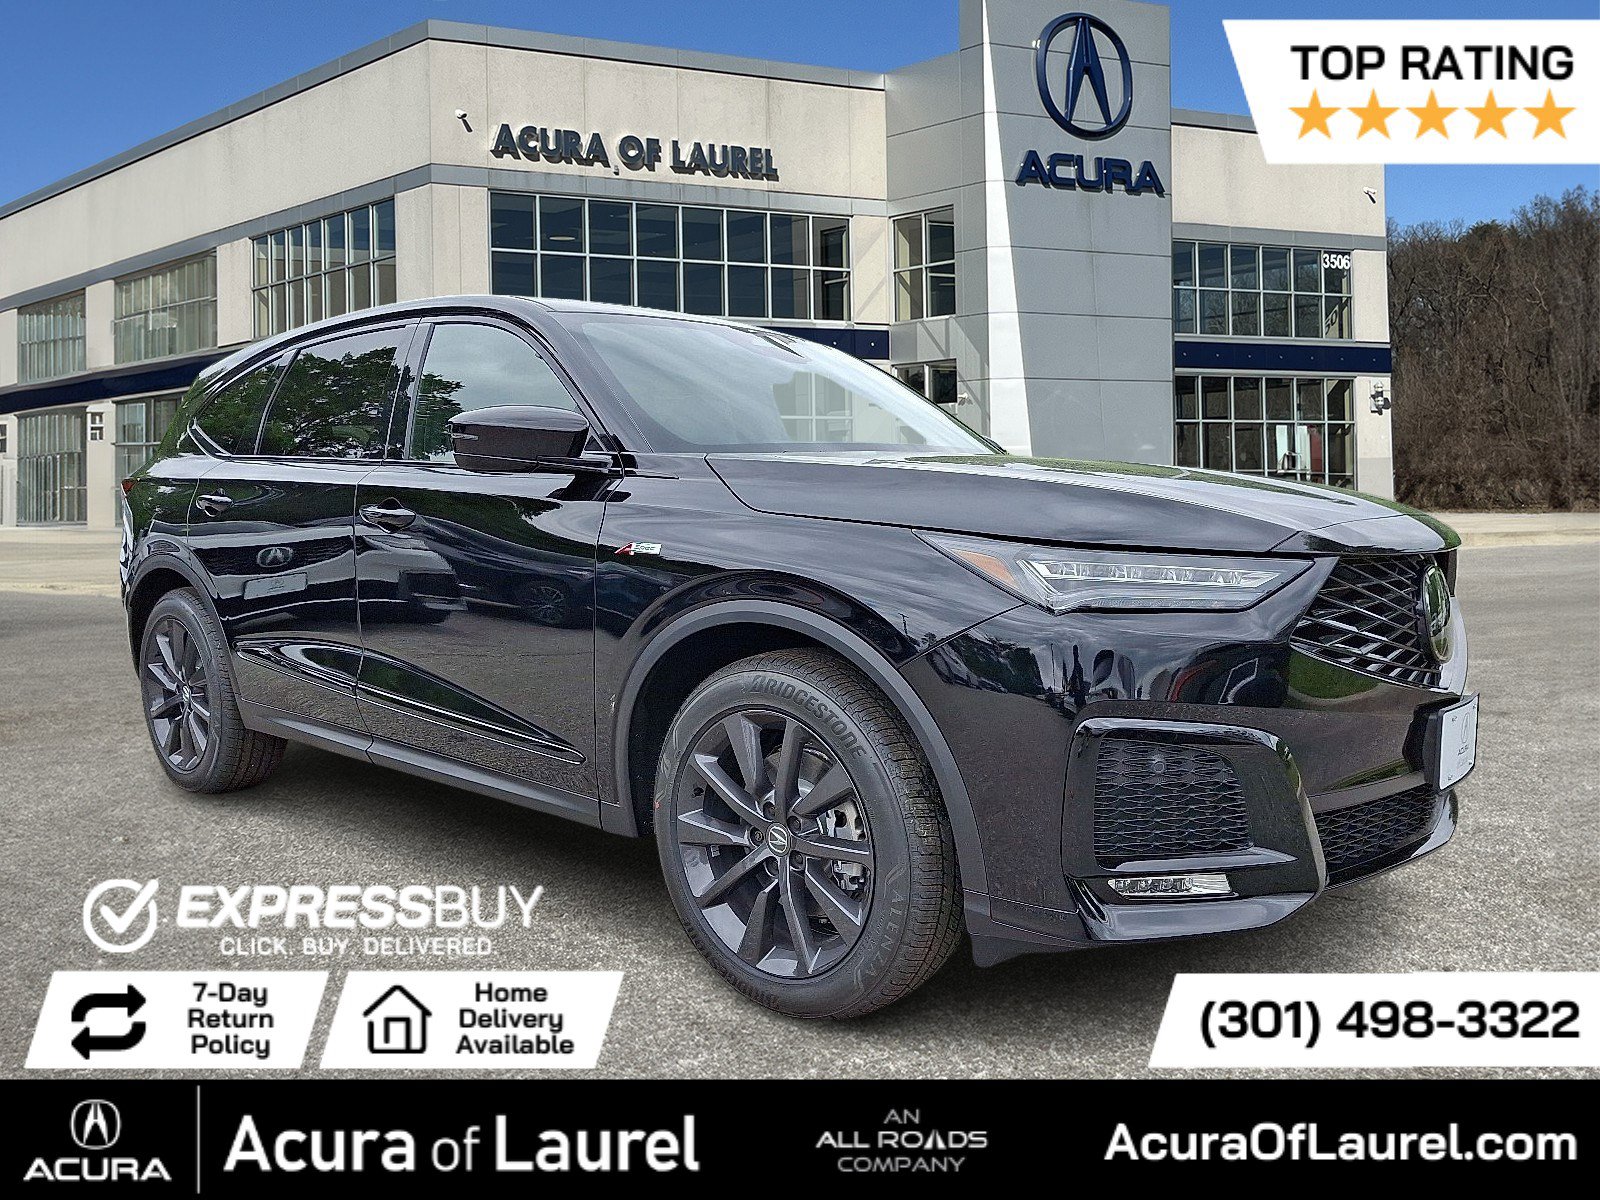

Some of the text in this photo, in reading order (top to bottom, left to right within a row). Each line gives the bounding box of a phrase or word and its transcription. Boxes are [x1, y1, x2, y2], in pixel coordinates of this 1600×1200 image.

[490, 123, 779, 182] ACURA OF LAUREL
[1015, 149, 1166, 199] ACURA
[1322, 253, 1351, 270] 3506
[749, 674, 867, 760] BRIDGESTONE
